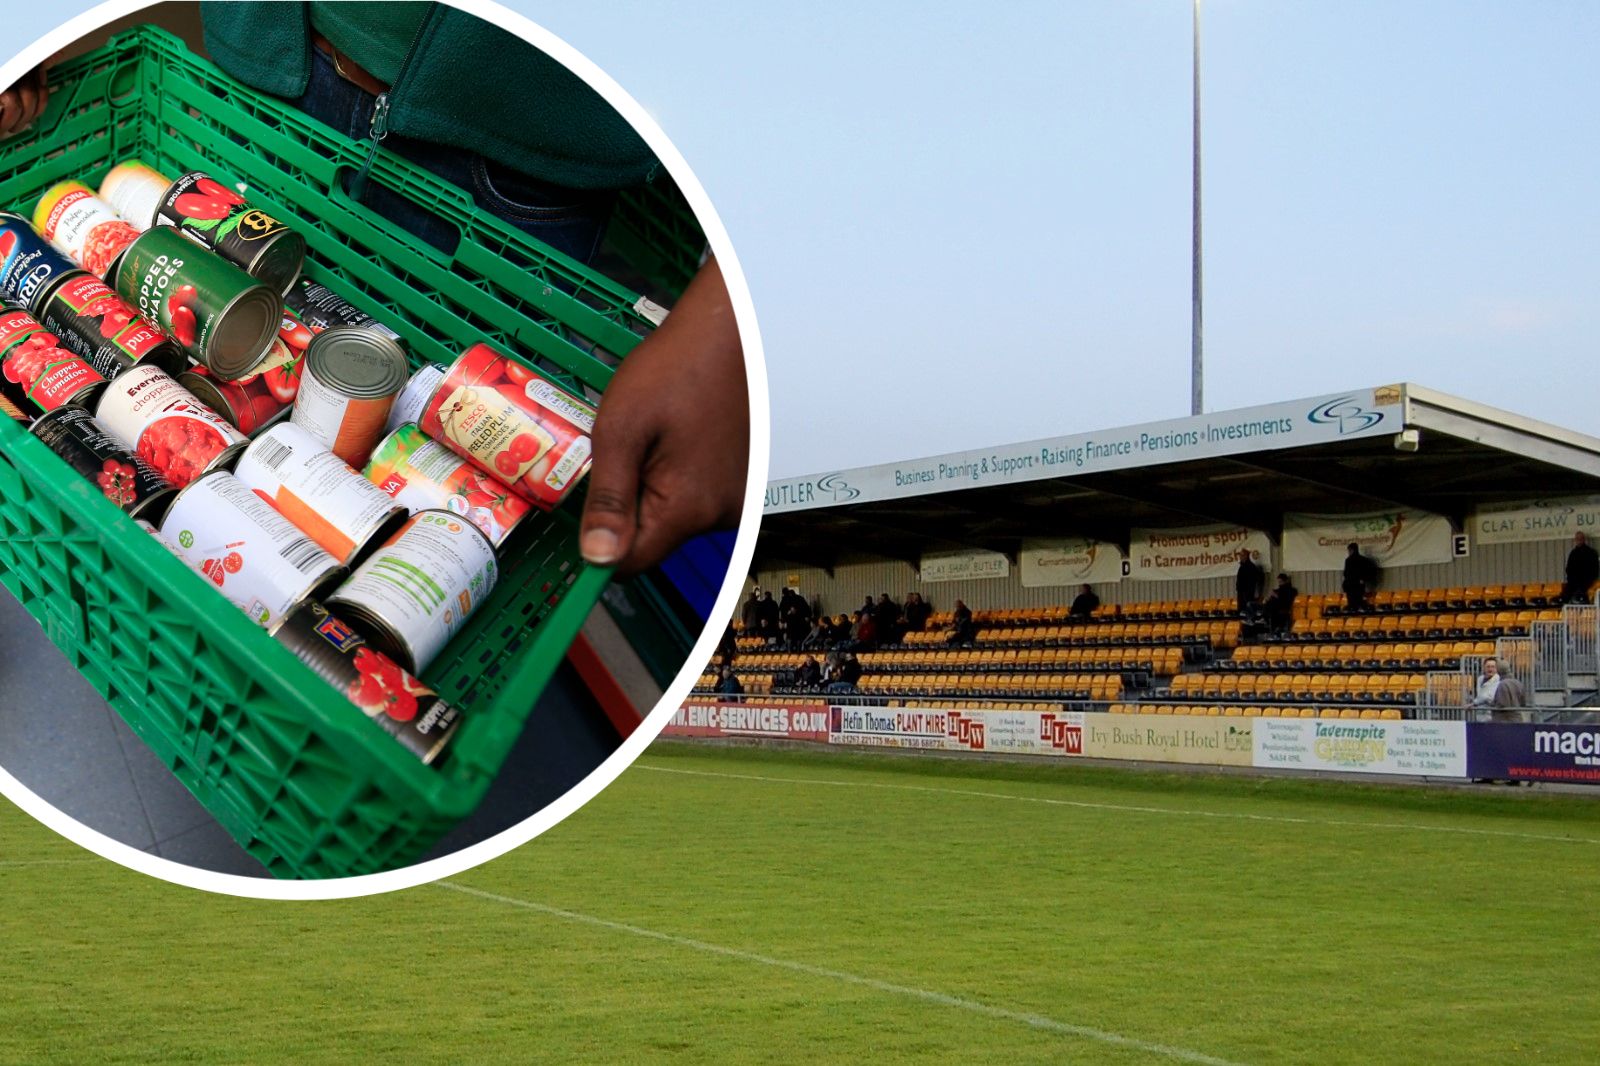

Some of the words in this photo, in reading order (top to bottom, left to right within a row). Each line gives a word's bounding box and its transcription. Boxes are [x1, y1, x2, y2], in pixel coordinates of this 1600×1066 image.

[46, 190, 89, 233] FRESHONA
[21, 248, 43, 270] Peeled
[41, 361, 79, 390] Chopped
[44, 367, 88, 397] Tomatoes
[132, 382, 173, 413] chopped
[458, 402, 486, 431] TESCO
[470, 414, 494, 438] ITALIAN
[490, 405, 516, 433] PLUM
[481, 422, 511, 451] TOMATOES
[895, 469, 935, 487] Business
[938, 460, 980, 481] Planning
[980, 456, 989, 473] &
[991, 453, 1033, 477] Support
[1041, 447, 1084, 467] Raising
[1085, 439, 1131, 460] Finance
[1140, 428, 1198, 451] Pensions
[1206, 415, 1293, 443] Investments
[764, 481, 815, 507] BUTLER
[1481, 519, 1516, 534] CLAY
[1524, 514, 1568, 531] SHAW
[1150, 533, 1211, 549] Promoting
[1214, 527, 1249, 546] sport
[1455, 536, 1467, 555] E
[972, 560, 1003, 572] BUTLER
[1122, 560, 1131, 576] D
[1140, 555, 1151, 568] in
[1154, 548, 1261, 568] Carmarthenshe
[843, 712, 863, 730] Hefin
[864, 712, 896, 732] Thomas
[896, 713, 924, 733] PLANT
[925, 713, 946, 734] HIRE
[1315, 721, 1386, 742] Tavernspite
[1091, 726, 1109, 748] Ivy
[1112, 726, 1143, 746] Bush
[1146, 728, 1180, 752] Royal
[1183, 730, 1219, 749] Hotel
[1386, 748, 1405, 757] Open
[1413, 750, 1430, 758] days
